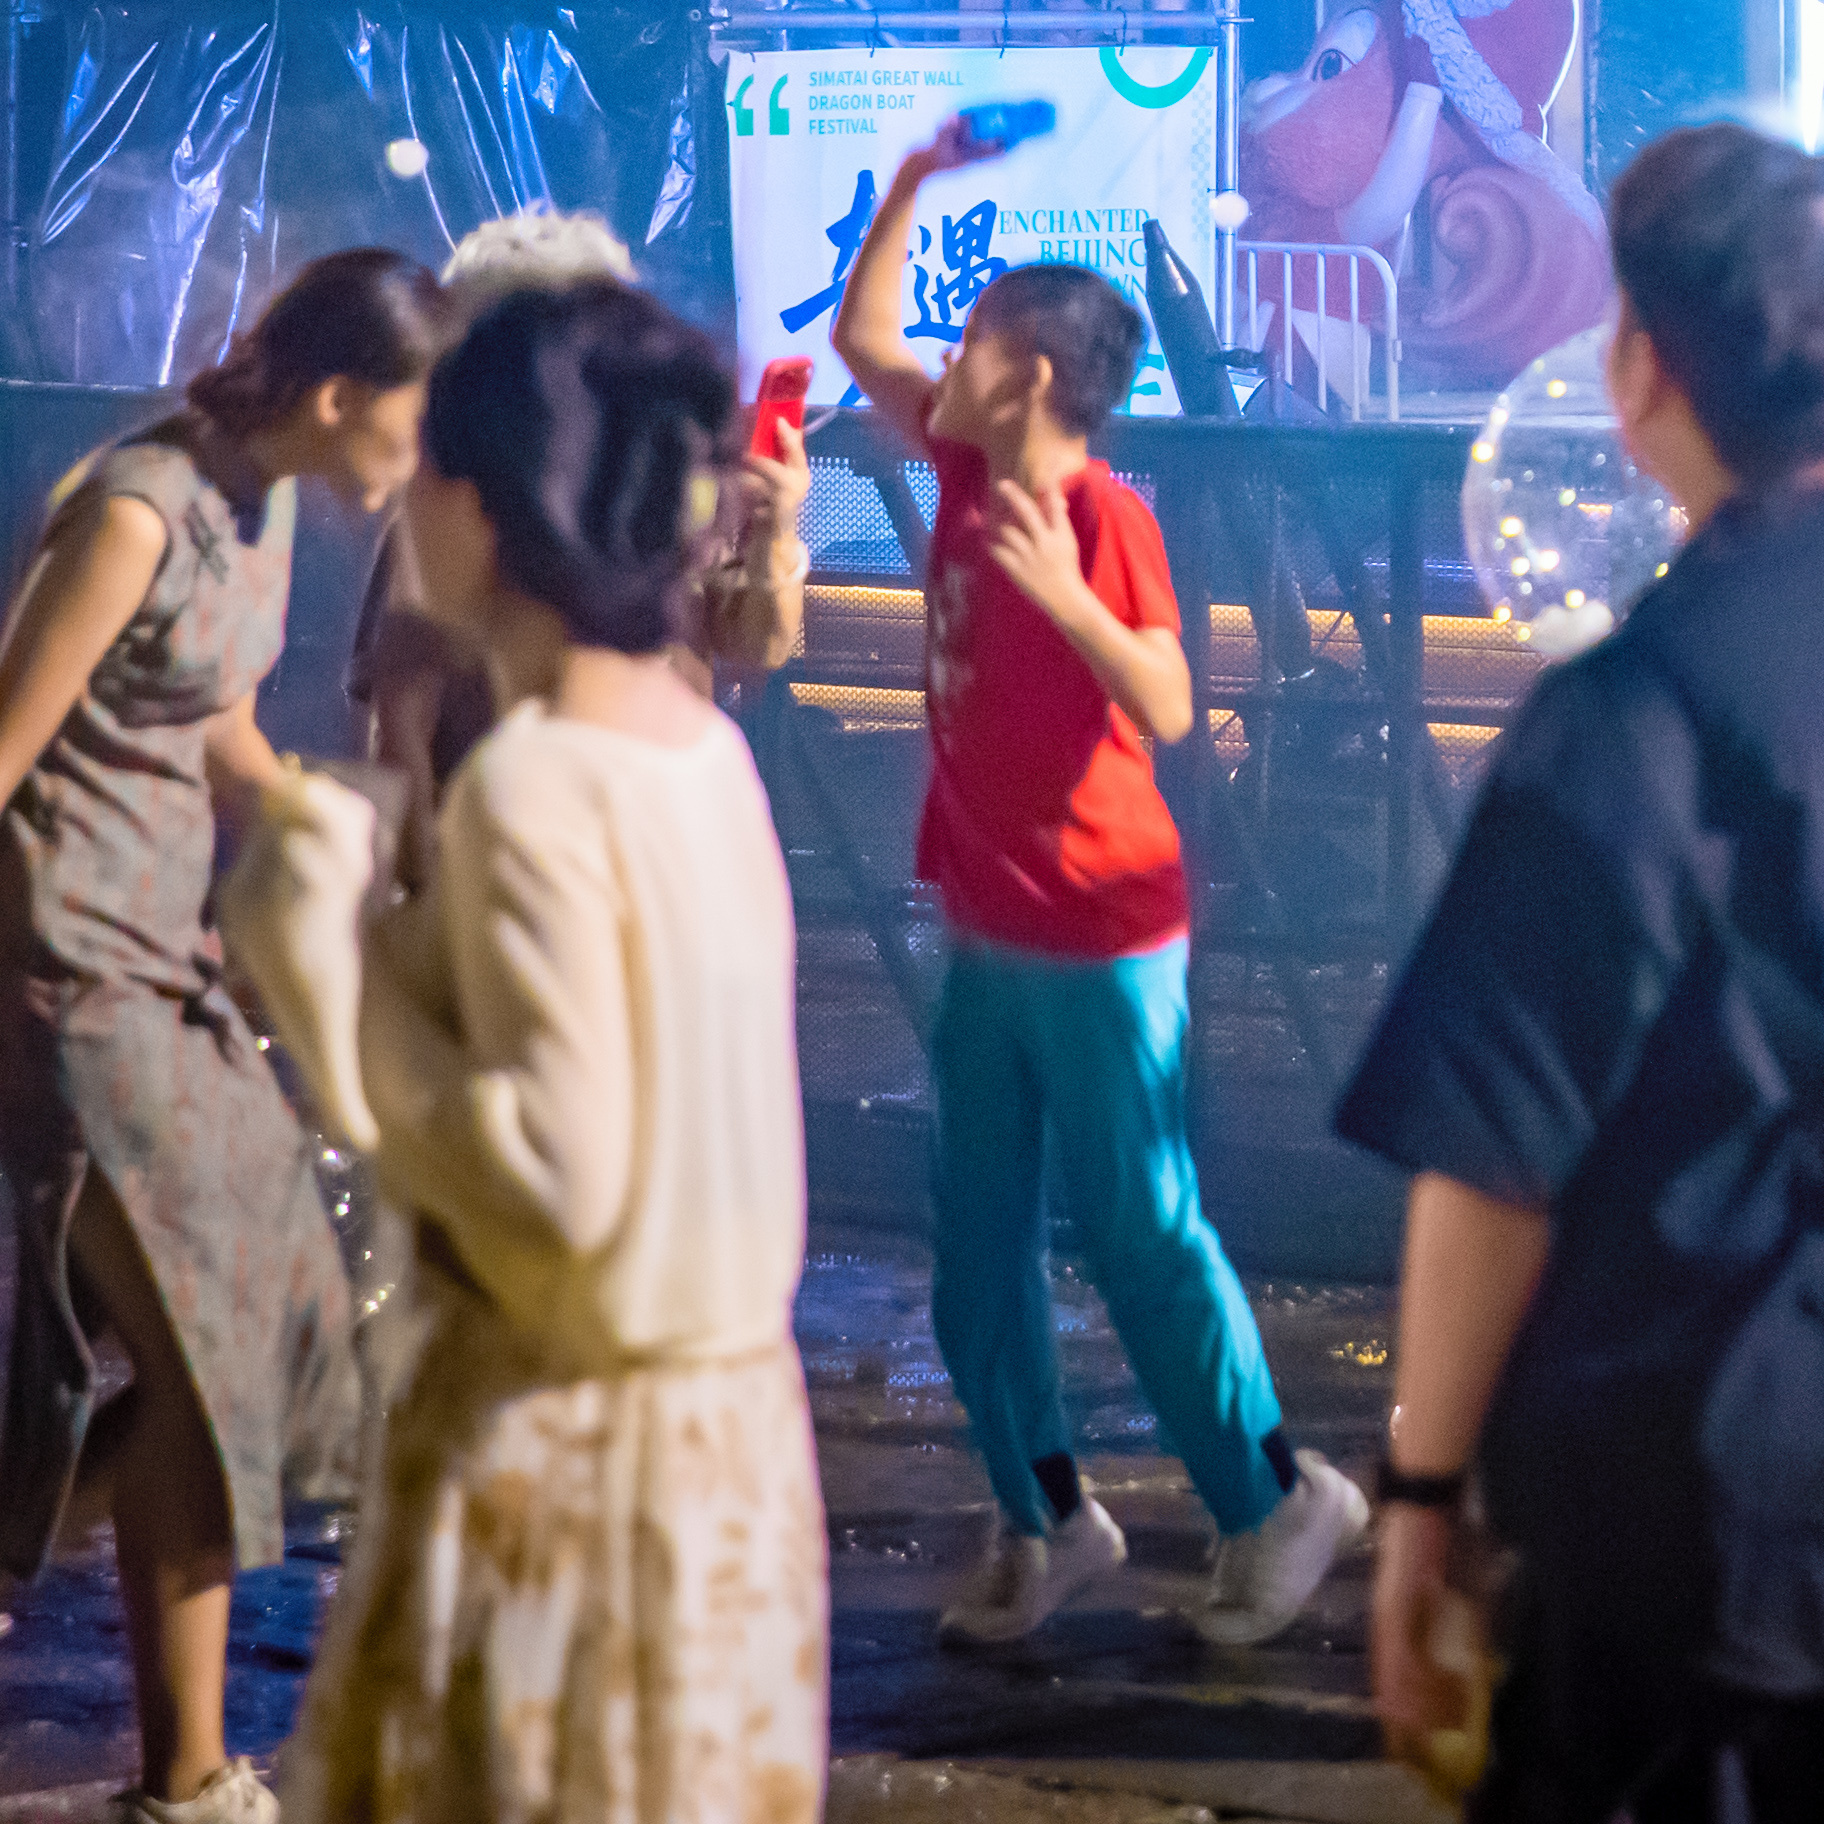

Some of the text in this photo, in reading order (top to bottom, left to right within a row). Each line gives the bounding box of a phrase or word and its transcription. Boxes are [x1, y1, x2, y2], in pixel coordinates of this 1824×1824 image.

[808, 69, 965, 87] SIMATAI GREAT WALL
[808, 94, 916, 111] DRAGON BOAT
[808, 117, 878, 135] FESTIVAL
[998, 208, 1150, 235] ENCHANTED
